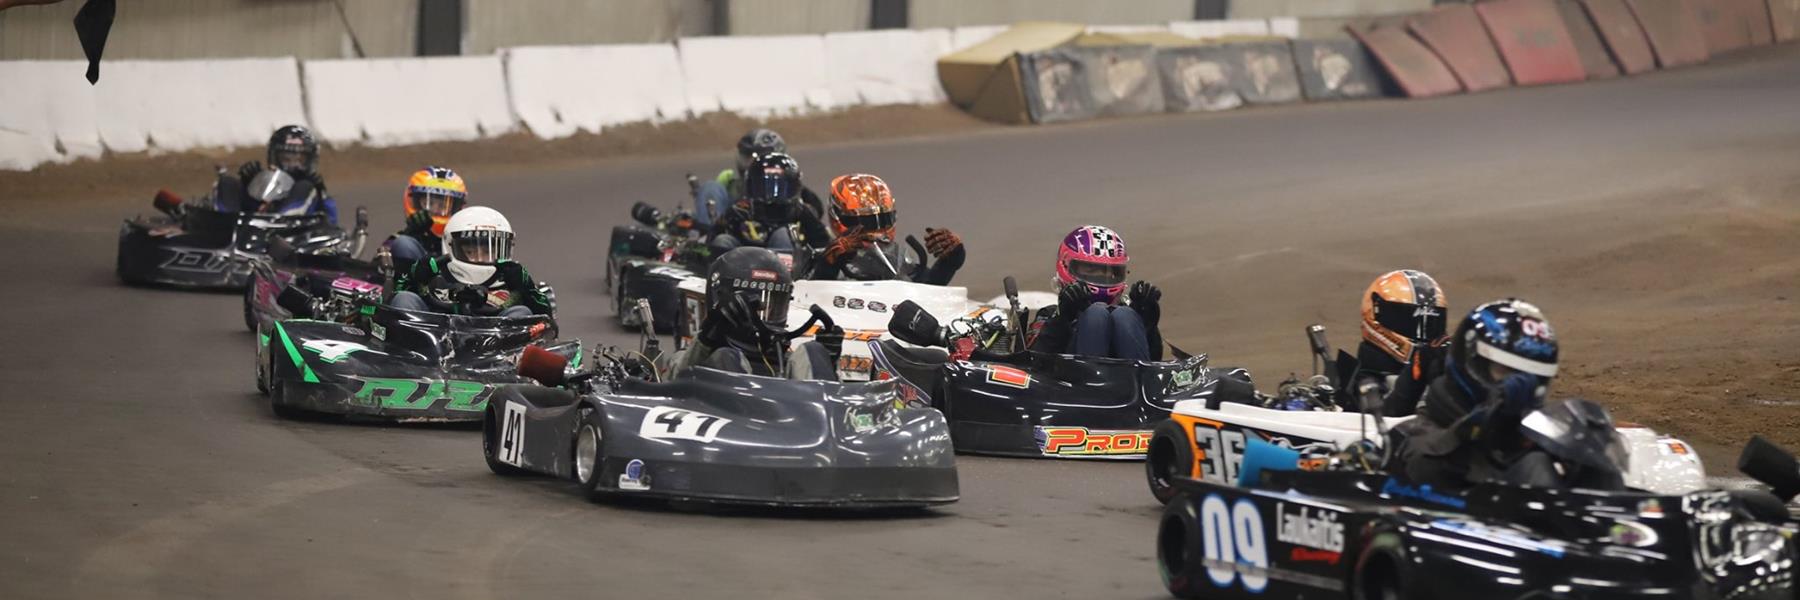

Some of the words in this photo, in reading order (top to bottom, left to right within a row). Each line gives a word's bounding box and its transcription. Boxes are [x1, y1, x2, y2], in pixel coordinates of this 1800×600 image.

[503, 409, 521, 464] 41
[1194, 424, 1246, 487] 36
[1202, 493, 1268, 592] 09
[1276, 501, 1346, 553] Laukaitis
